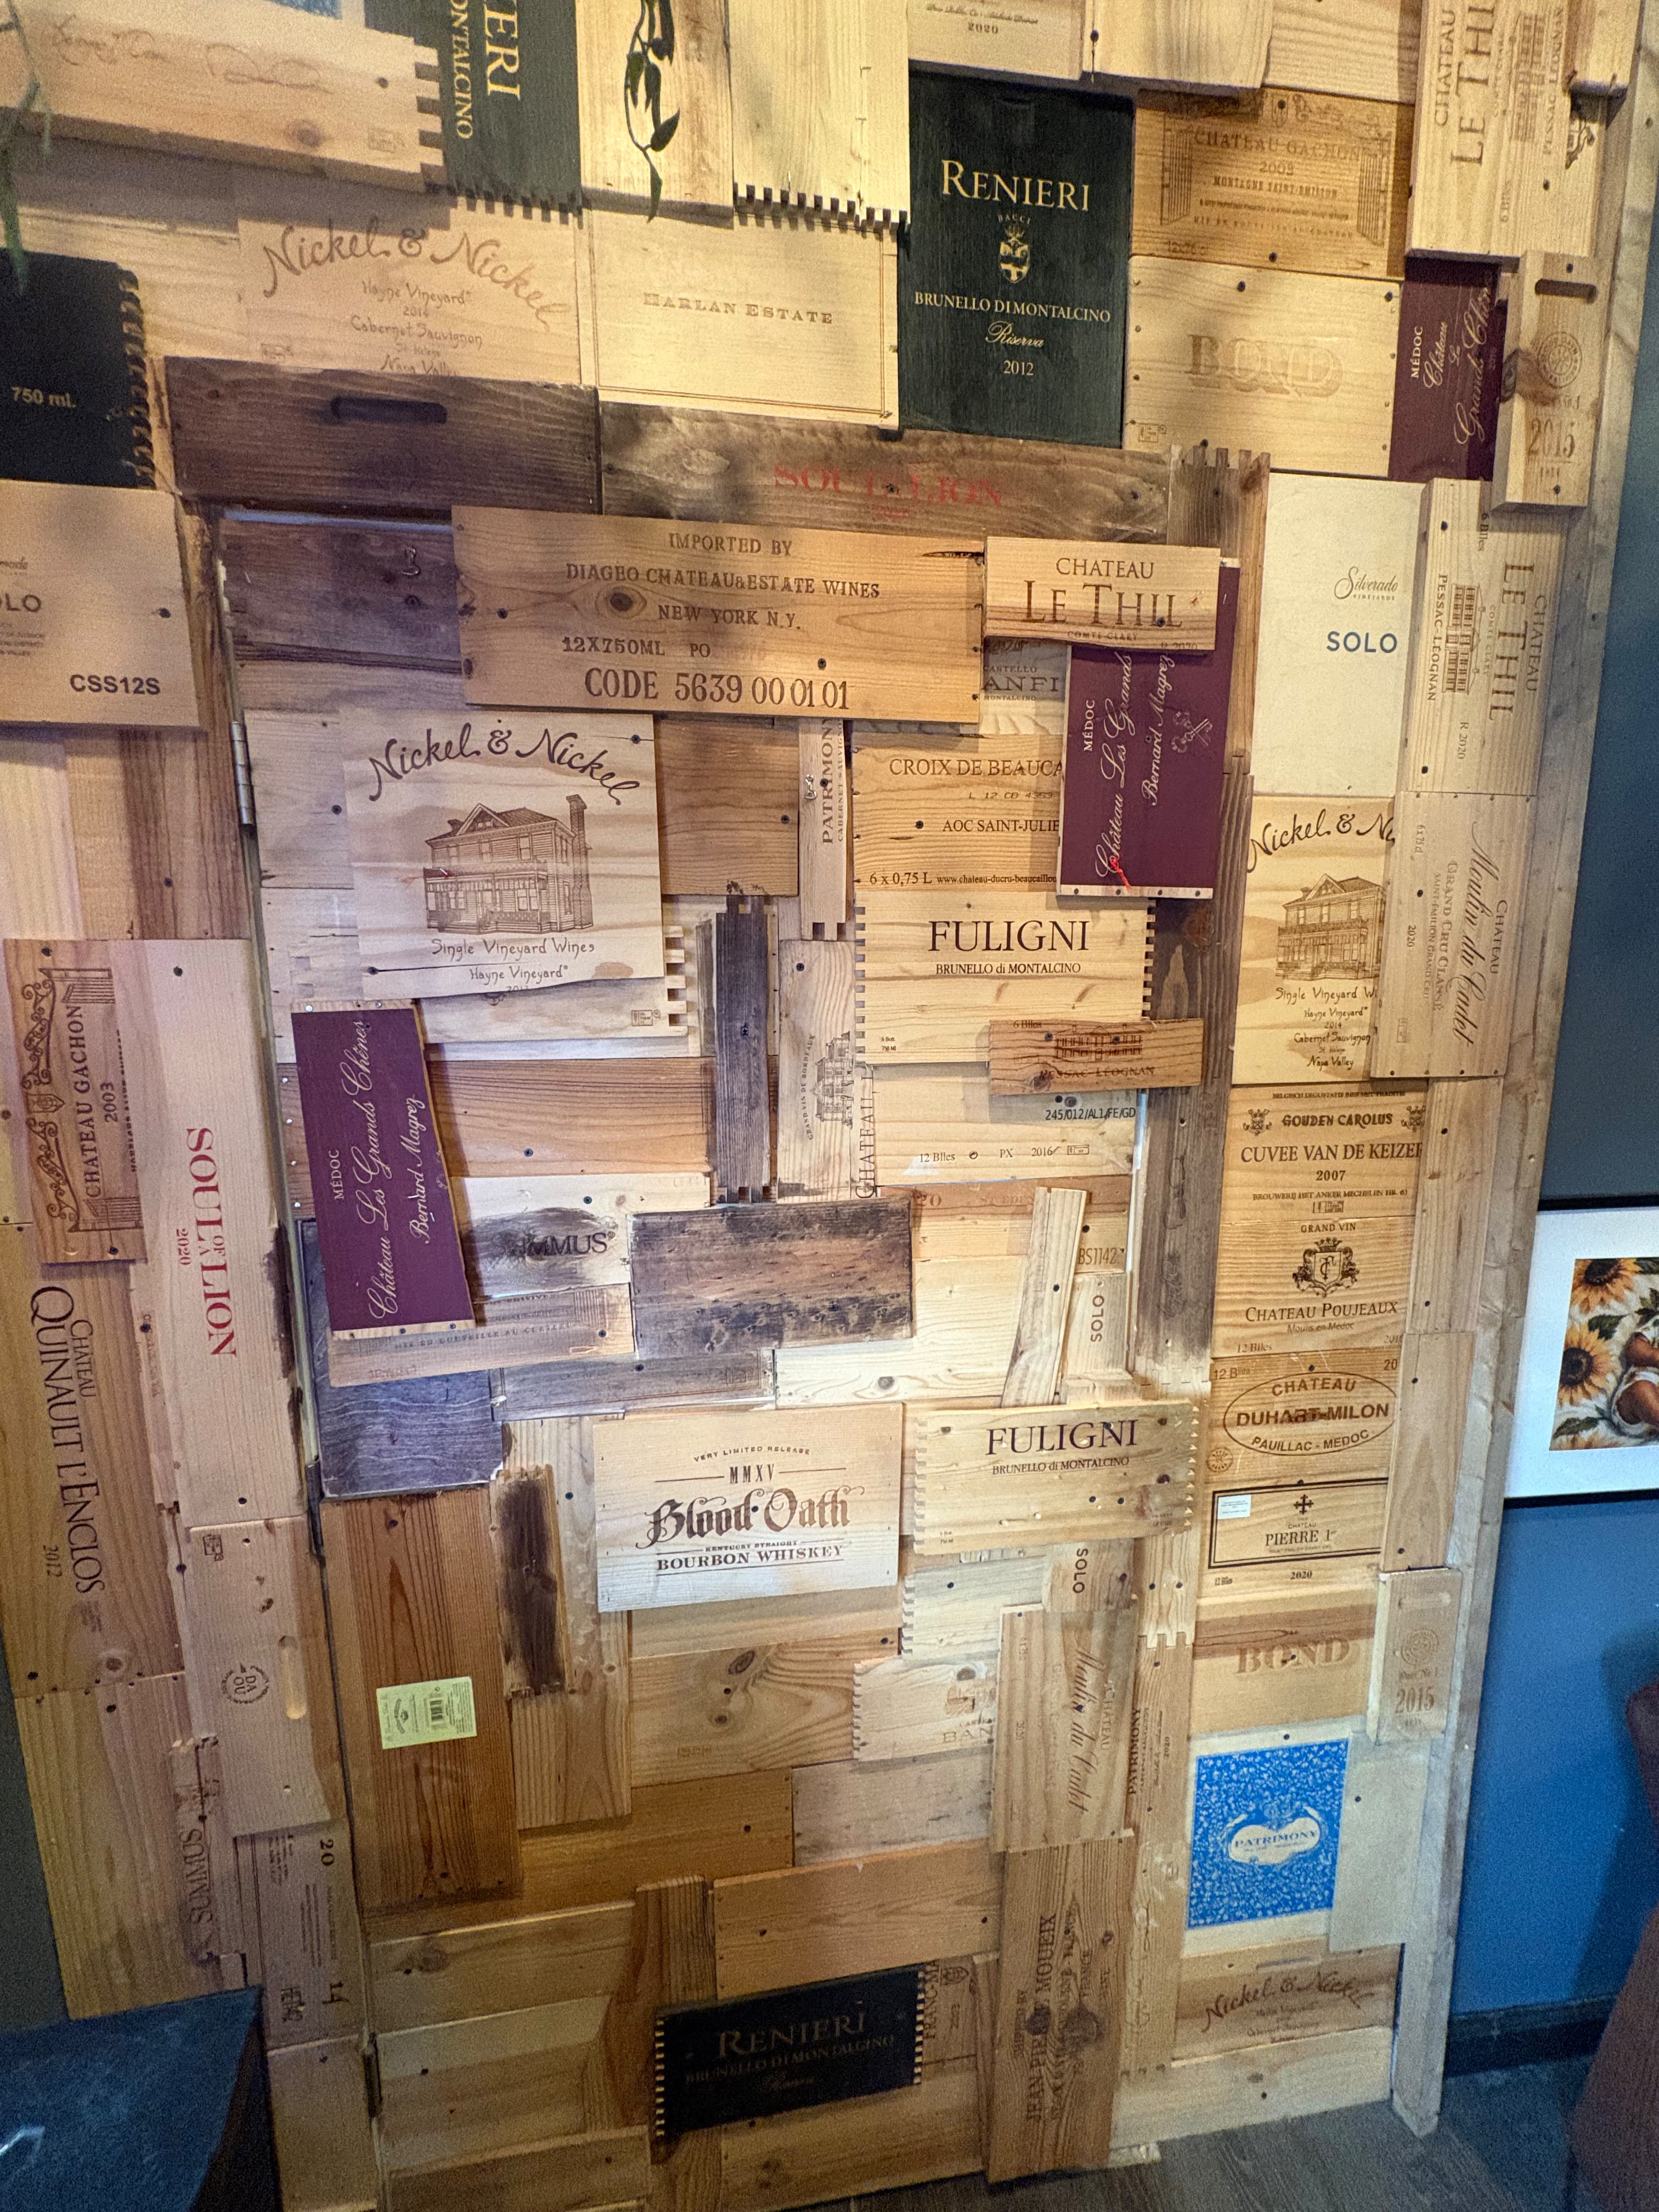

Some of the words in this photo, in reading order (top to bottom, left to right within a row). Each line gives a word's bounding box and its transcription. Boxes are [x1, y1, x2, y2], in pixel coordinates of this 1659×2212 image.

[450, 0, 474, 139] ONTALCINO
[1451, 116, 1486, 165] LE
[942, 160, 1090, 211] RENIERI
[263, 216, 390, 298] Nickel
[399, 228, 427, 257] &
[644, 292, 736, 314] HARLAN
[746, 303, 833, 324] ESTATE
[915, 291, 990, 311] BRUNELLO
[1012, 302, 1111, 323] MONTALCINO
[985, 320, 1045, 348] Riserva
[1003, 360, 1034, 376] 2012
[1410, 326, 1424, 379] MÉDOC
[12, 386, 44, 404] 750
[669, 532, 761, 554] IMPORTED
[772, 539, 792, 556] BY
[566, 563, 639, 582] DIAGEO
[823, 580, 880, 599] WINES
[1056, 557, 1155, 580] CHATEAU
[1334, 566, 1398, 600] Silverado
[1501, 562, 1534, 605] LE
[659, 605, 701, 622] NEW
[712, 608, 759, 625] YORK
[1023, 580, 1068, 624] LE
[1082, 583, 1183, 628] THIL
[690, 643, 711, 658] PO
[1326, 631, 1398, 653] SOLO
[1526, 595, 1547, 692] CHATEAU
[70, 674, 161, 696] CSS12S
[585, 667, 658, 699] CODE
[675, 673, 742, 704] 5639
[981, 676, 1059, 692] ANFI
[1489, 621, 1528, 721] THIL
[1104, 652, 1136, 738] Grands
[1084, 699, 1096, 752] MÉDOC
[1457, 733, 1469, 760] 2020
[368, 722, 480, 801] Nickel
[488, 720, 512, 755] &
[516, 728, 640, 805] Nickel
[889, 759, 951, 776] CROIX
[956, 759, 983, 776] DE
[1142, 725, 1163, 806] Bernard
[943, 820, 974, 832] AOC
[1096, 793, 1125, 878] Château
[1246, 809, 1331, 873] Nickel
[1337, 814, 1356, 833] &
[870, 873, 878, 884] 6
[881, 876, 888, 884] x
[893, 872, 918, 887] 0,75
[923, 872, 932, 884] L
[1443, 860, 1458, 917] GRAND
[1465, 821, 1499, 930] Moulin
[432, 938, 475, 964] Single
[484, 938, 546, 965] Vineyard
[552, 938, 595, 959] Wines
[928, 920, 1090, 952] FULIGNI
[1407, 925, 1416, 947] 2020
[470, 967, 505, 985] Hayne
[936, 963, 993, 975] BRUNELLO
[996, 963, 1005, 974] di
[1008, 962, 1081, 974] MONTALCINO
[1276, 988, 1306, 1005] Single
[1313, 988, 1357, 1005] Vineyard
[65, 1005, 92, 1094] GACHON
[1294, 1032, 1330, 1045] Cabernet
[1331, 1032, 1371, 1046] Sauvignon
[340, 1020, 374, 1097] Chênes
[1307, 1057, 1329, 1068] Napa
[1331, 1057, 1354, 1070] Valley
[801, 1081, 806, 1092] DE
[99, 1082, 119, 1123] 2003
[399, 1096, 425, 1169] Magrez
[804, 1110, 814, 1141] GRAND
[1282, 1114, 1334, 1127] GOUDEN
[1338, 1113, 1393, 1129] CAROLUS
[75, 1102, 103, 1199] CHATEAU
[352, 1100, 392, 1184] Grands
[920, 1154, 930, 1163] 12
[1000, 1148, 1013, 1158] PX
[1031, 1147, 1053, 1157] 2016
[1241, 1146, 1299, 1163] CUVEE
[1303, 1144, 1338, 1161] VAN
[1342, 1143, 1365, 1160] DE
[185, 1127, 223, 1241] SOUL
[329, 1149, 345, 1200] MÉDOC
[1316, 1170, 1346, 1182] 2007
[357, 1188, 388, 1231] Les
[409, 1169, 431, 1244] Bernard
[1253, 1192, 1296, 1201] BROUWERIJ
[1301, 1224, 1335, 1233] GRAND
[1339, 1223, 1356, 1232] VIN
[176, 1228, 190, 1265] 2020
[212, 1235, 225, 1256] OF
[368, 1237, 398, 1319] Château
[200, 1260, 237, 1358] LION
[1091, 1294, 1105, 1342] SOLO
[1245, 1305, 1316, 1322] CHATEAU
[1322, 1301, 1398, 1319] POUJEAUX
[30, 1286, 86, 1453] QUINAULT
[1214, 1369, 1227, 1380] 12
[1272, 1377, 1356, 1396] CHATEAU
[985, 1419, 1139, 1456] FULIGNI
[1251, 1436, 1312, 1452] PAUILLAC
[1323, 1429, 1369, 1449] MEDOC
[693, 1451, 718, 1462] VERY
[723, 1446, 763, 1456] LIMITED
[768, 1446, 811, 1456] RELEASE
[992, 1462, 1046, 1475] BRUNELLO
[1049, 1460, 1059, 1471] di
[1060, 1456, 1130, 1471] MONTALCINO
[729, 1464, 775, 1485] MMXV
[635, 1488, 765, 1550] Blood
[764, 1485, 865, 1533] Oath
[706, 1543, 752, 1552] KENTUCKY
[755, 1540, 798, 1549] STRAIGHT
[1265, 1530, 1319, 1547] PIERRE
[657, 1552, 750, 1571] BOURBON
[758, 1544, 844, 1564] WHISKEY
[1073, 1548, 1089, 1594] SOLO
[1290, 1571, 1312, 1581] 2020
[1395, 1686, 1435, 1715] 2015
[1234, 1829, 1318, 1848] PATRIMONY
[719, 2010, 867, 2059] RENIERI
